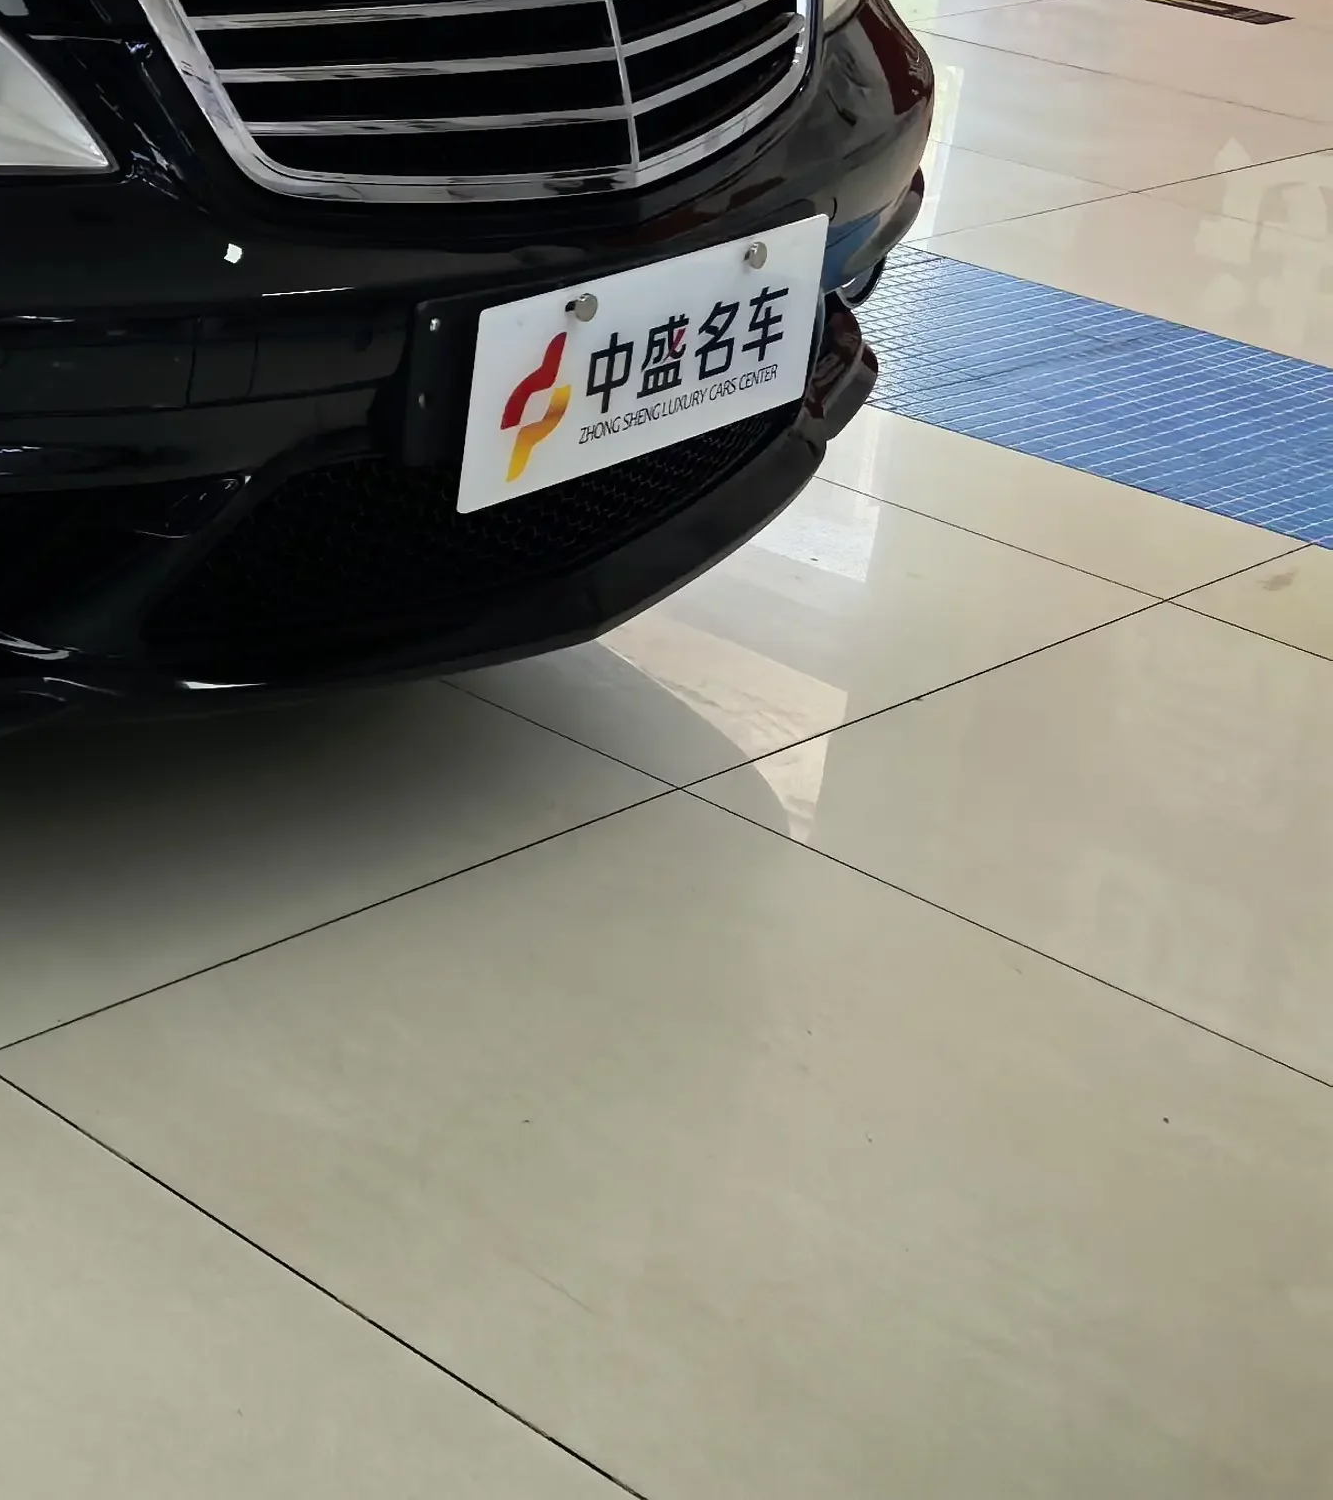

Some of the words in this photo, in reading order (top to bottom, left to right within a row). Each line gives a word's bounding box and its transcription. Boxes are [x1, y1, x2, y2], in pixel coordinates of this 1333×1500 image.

[585, 286, 789, 414] 中盛名车
[578, 415, 622, 445] ZHONG
[623, 405, 661, 430] SHENG
[662, 389, 708, 417] LUXURY
[709, 377, 738, 402] CARS
[739, 363, 779, 391] CENTER
